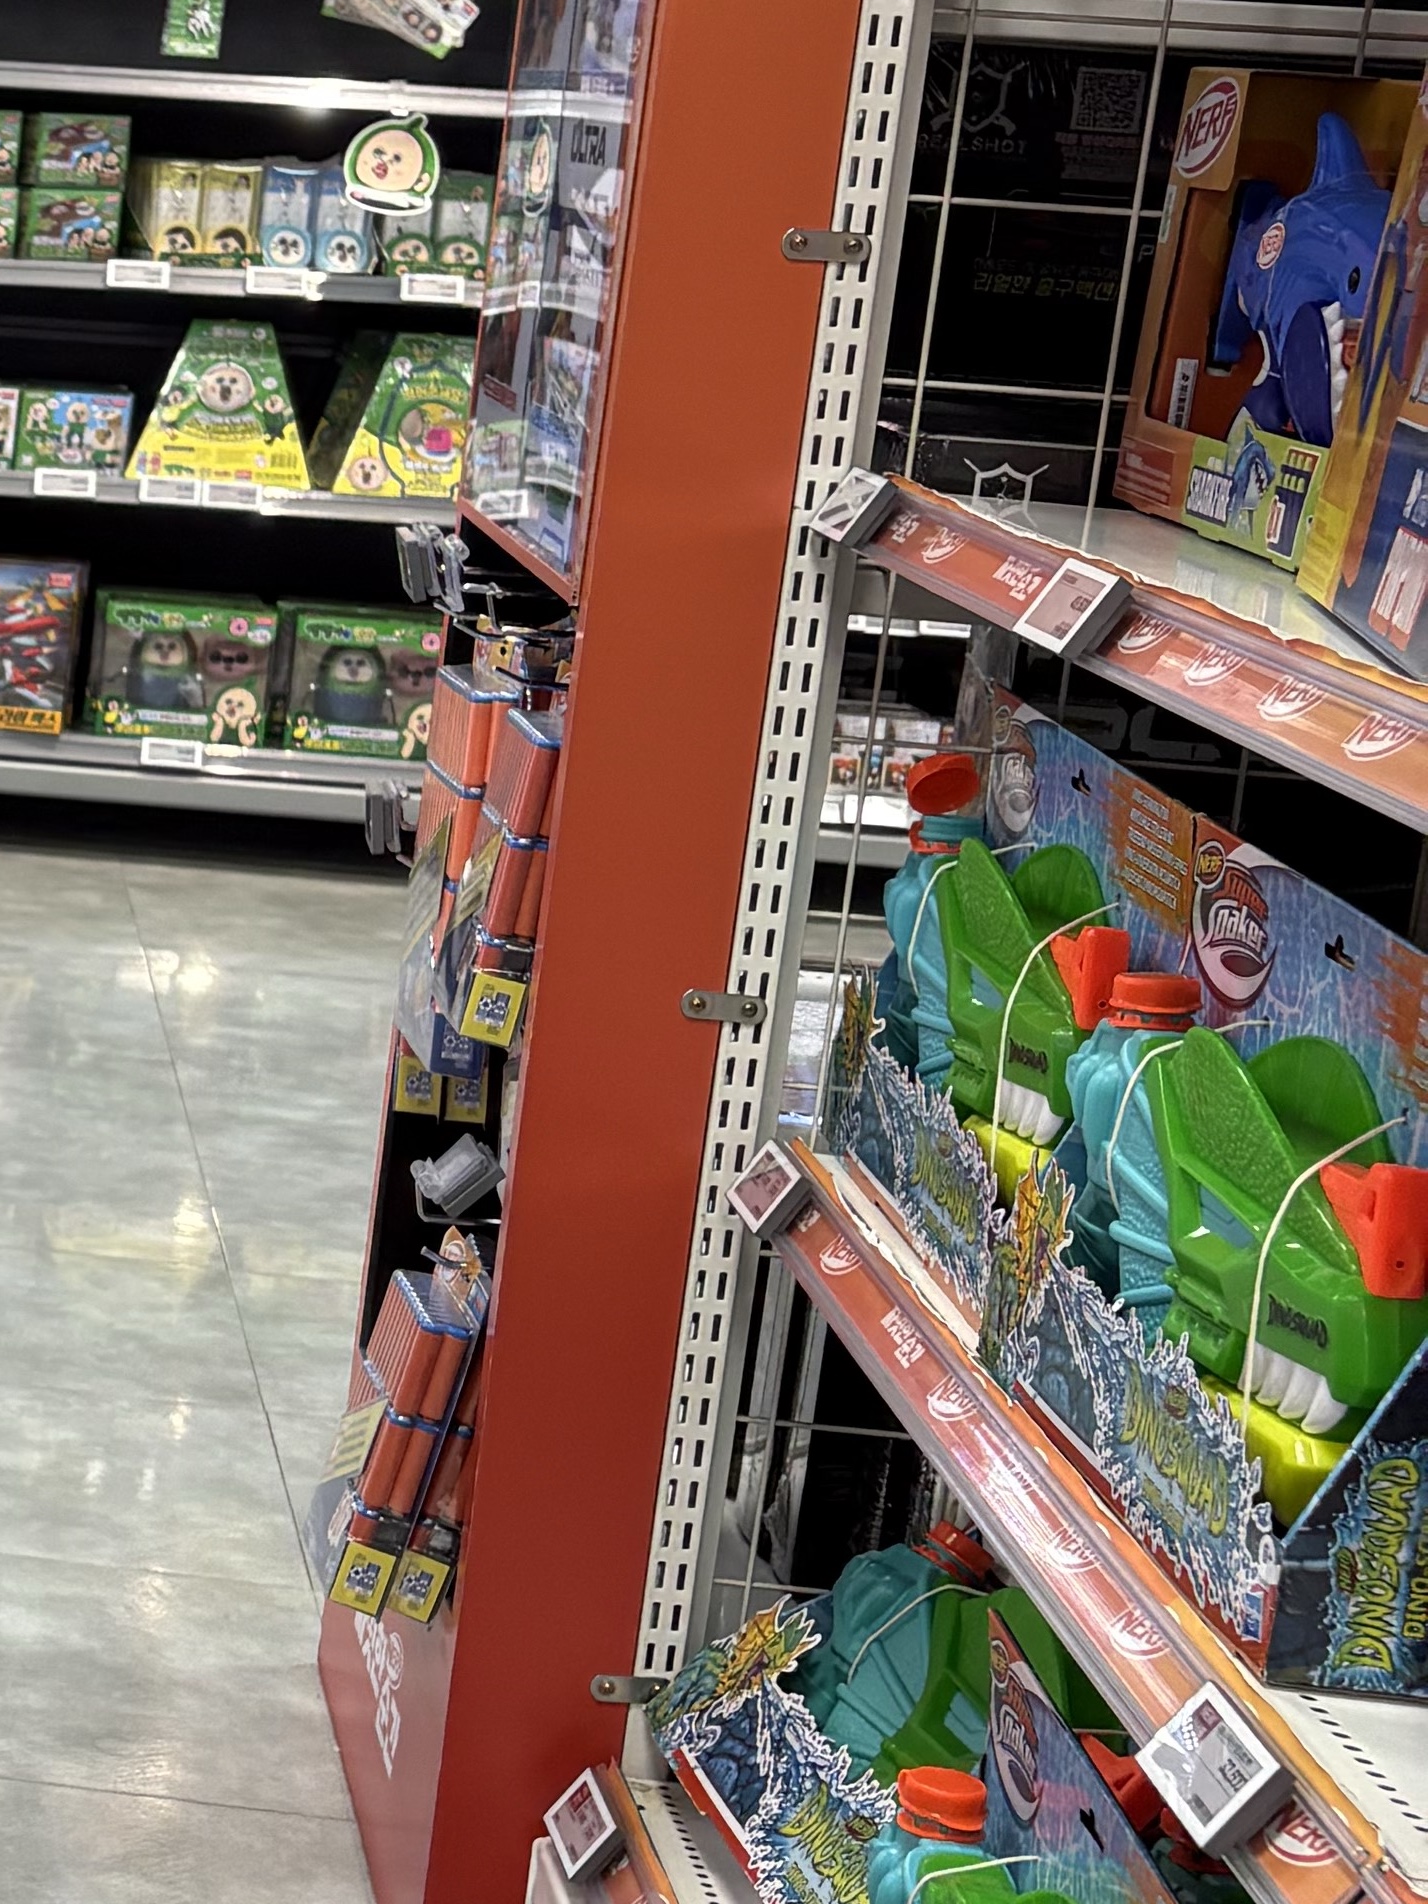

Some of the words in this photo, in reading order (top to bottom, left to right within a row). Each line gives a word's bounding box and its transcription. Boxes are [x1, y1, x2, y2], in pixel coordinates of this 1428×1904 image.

[1181, 92, 1237, 158] NERF
[1197, 852, 1223, 876] NERF
[1333, 1457, 1419, 1674] DINOSQUAD
